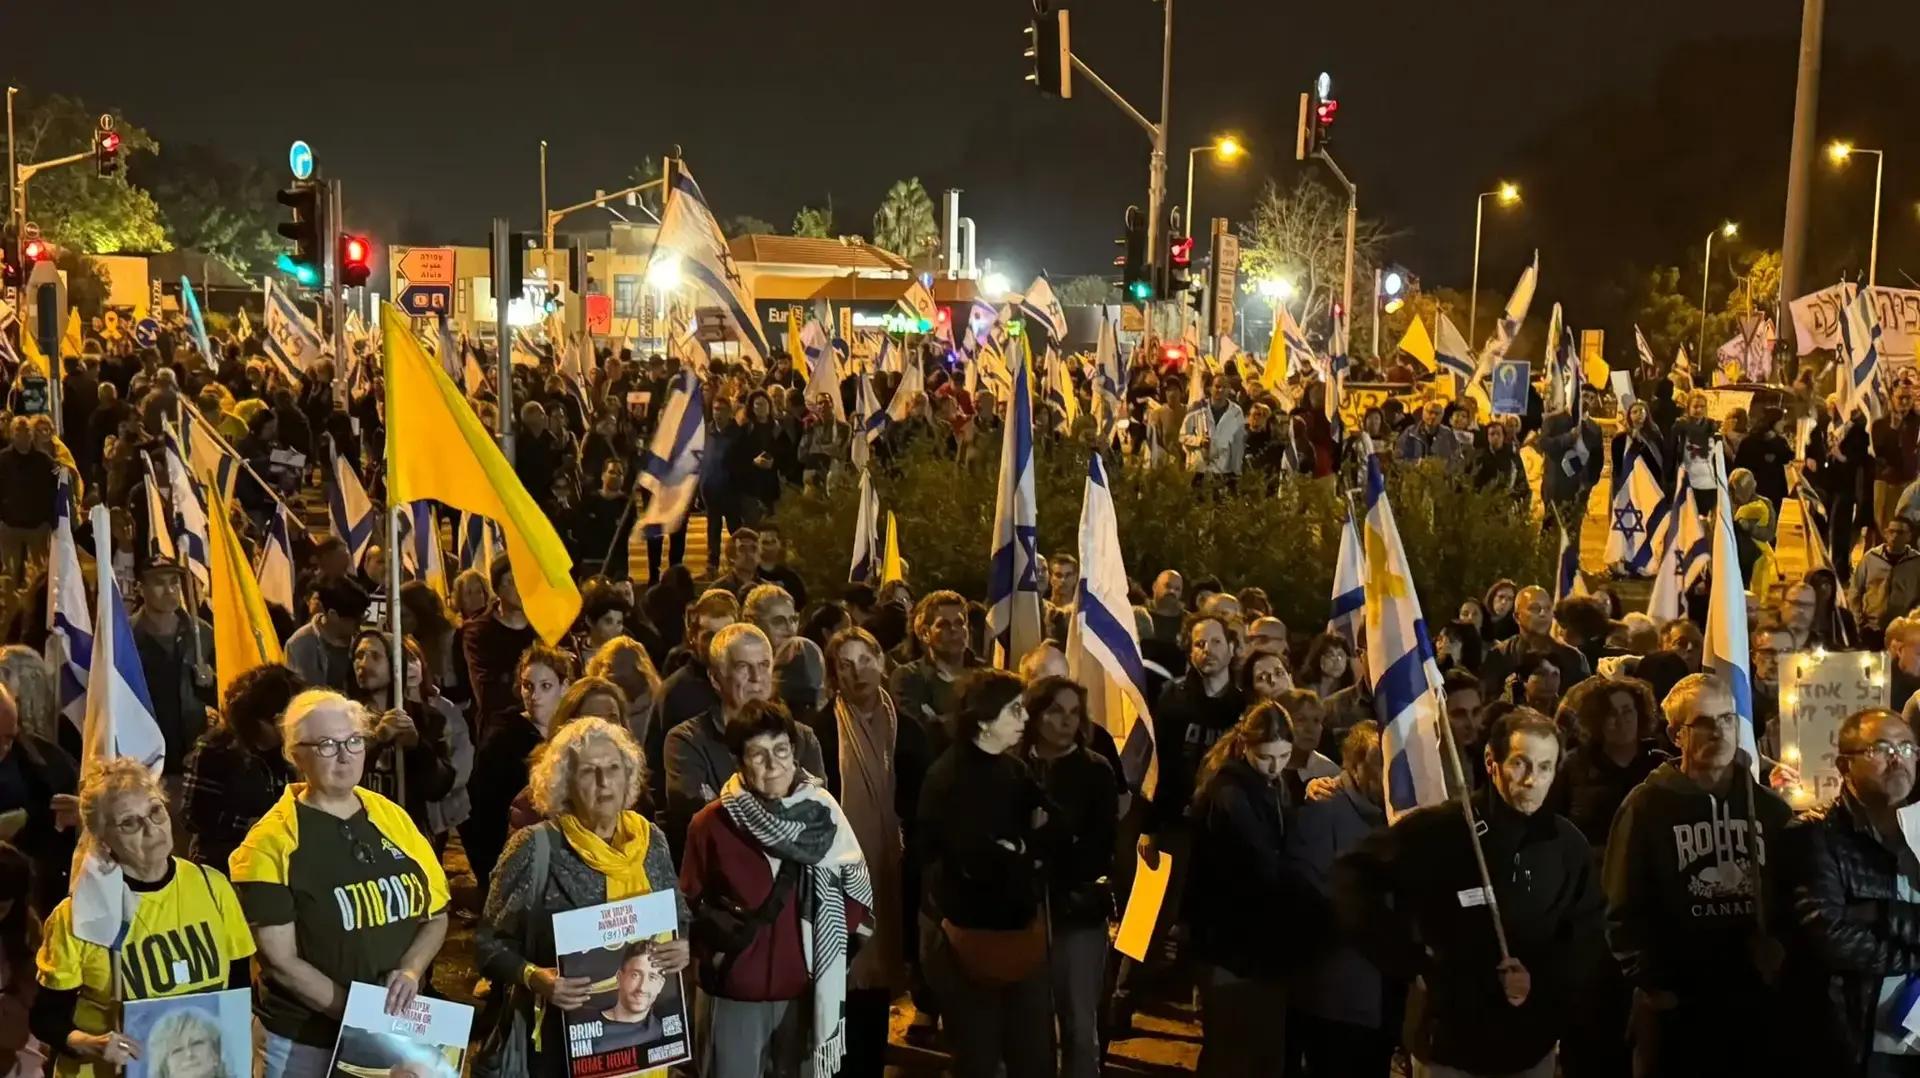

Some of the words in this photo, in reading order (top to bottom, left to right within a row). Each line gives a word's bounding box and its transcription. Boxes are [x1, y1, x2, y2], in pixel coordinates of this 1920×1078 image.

[768, 307, 789, 323] Eur
[334, 872, 425, 931] 07102023
[1692, 901, 1754, 917] CANAD
[598, 916, 629, 931] AVINATAN
[629, 914, 638, 924] OR
[603, 929, 621, 942] (31)
[121, 921, 220, 999] NOW
[569, 1020, 603, 1041] BRING
[570, 1039, 593, 1058] HIM
[572, 1055, 605, 1075] HOME
[606, 1047, 639, 1069] NOW!
